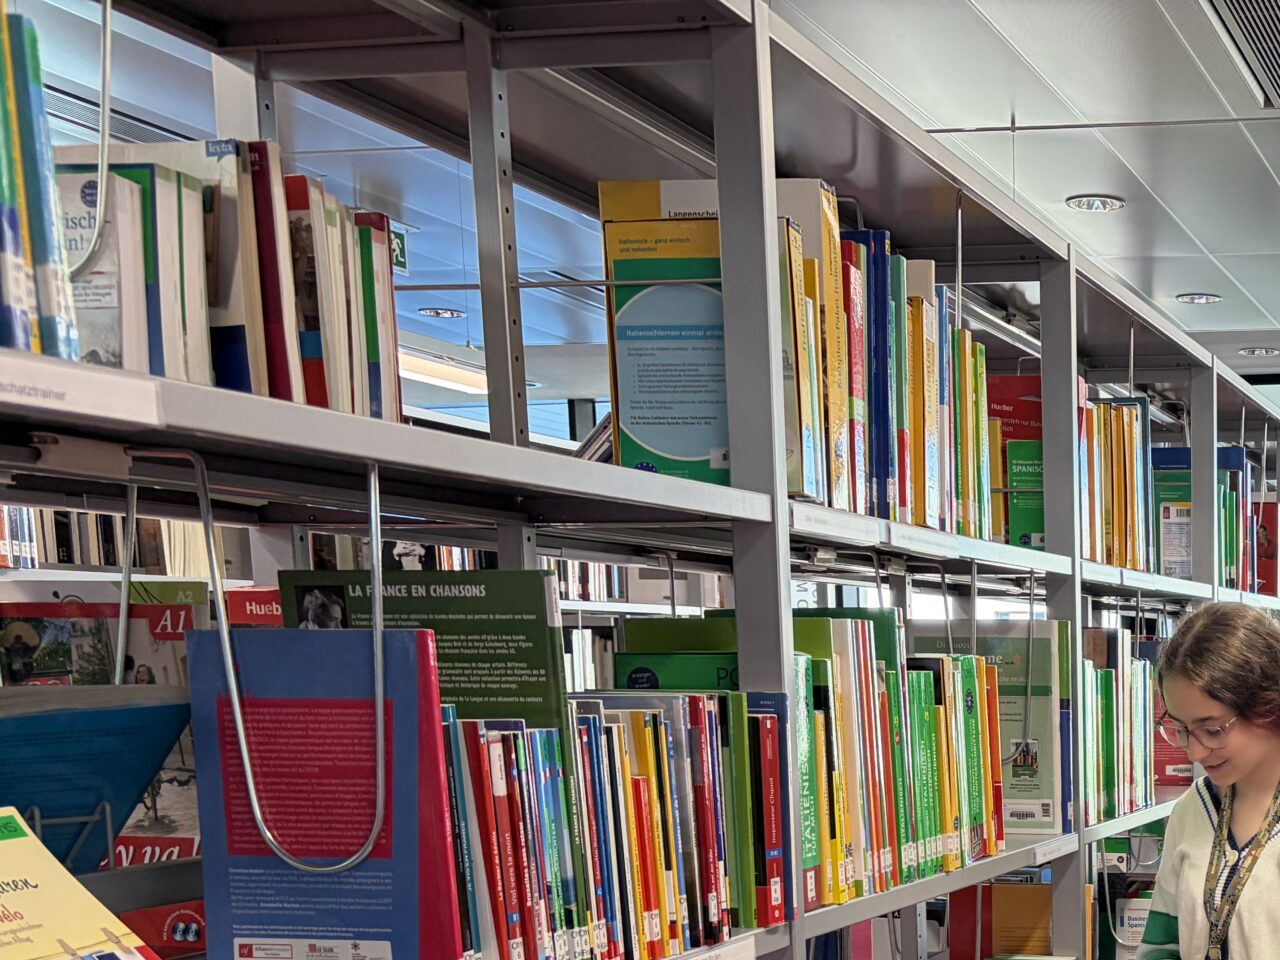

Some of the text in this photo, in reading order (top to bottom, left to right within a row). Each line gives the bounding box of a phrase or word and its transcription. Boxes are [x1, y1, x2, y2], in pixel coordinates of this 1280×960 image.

[991, 403, 1014, 411] Hueber
[348, 585, 486, 597] LA FANCE EN CHANSONS
[246, 601, 281, 616] Hueb
[155, 608, 186, 633] A1
[771, 804, 779, 844] Inspecteur
